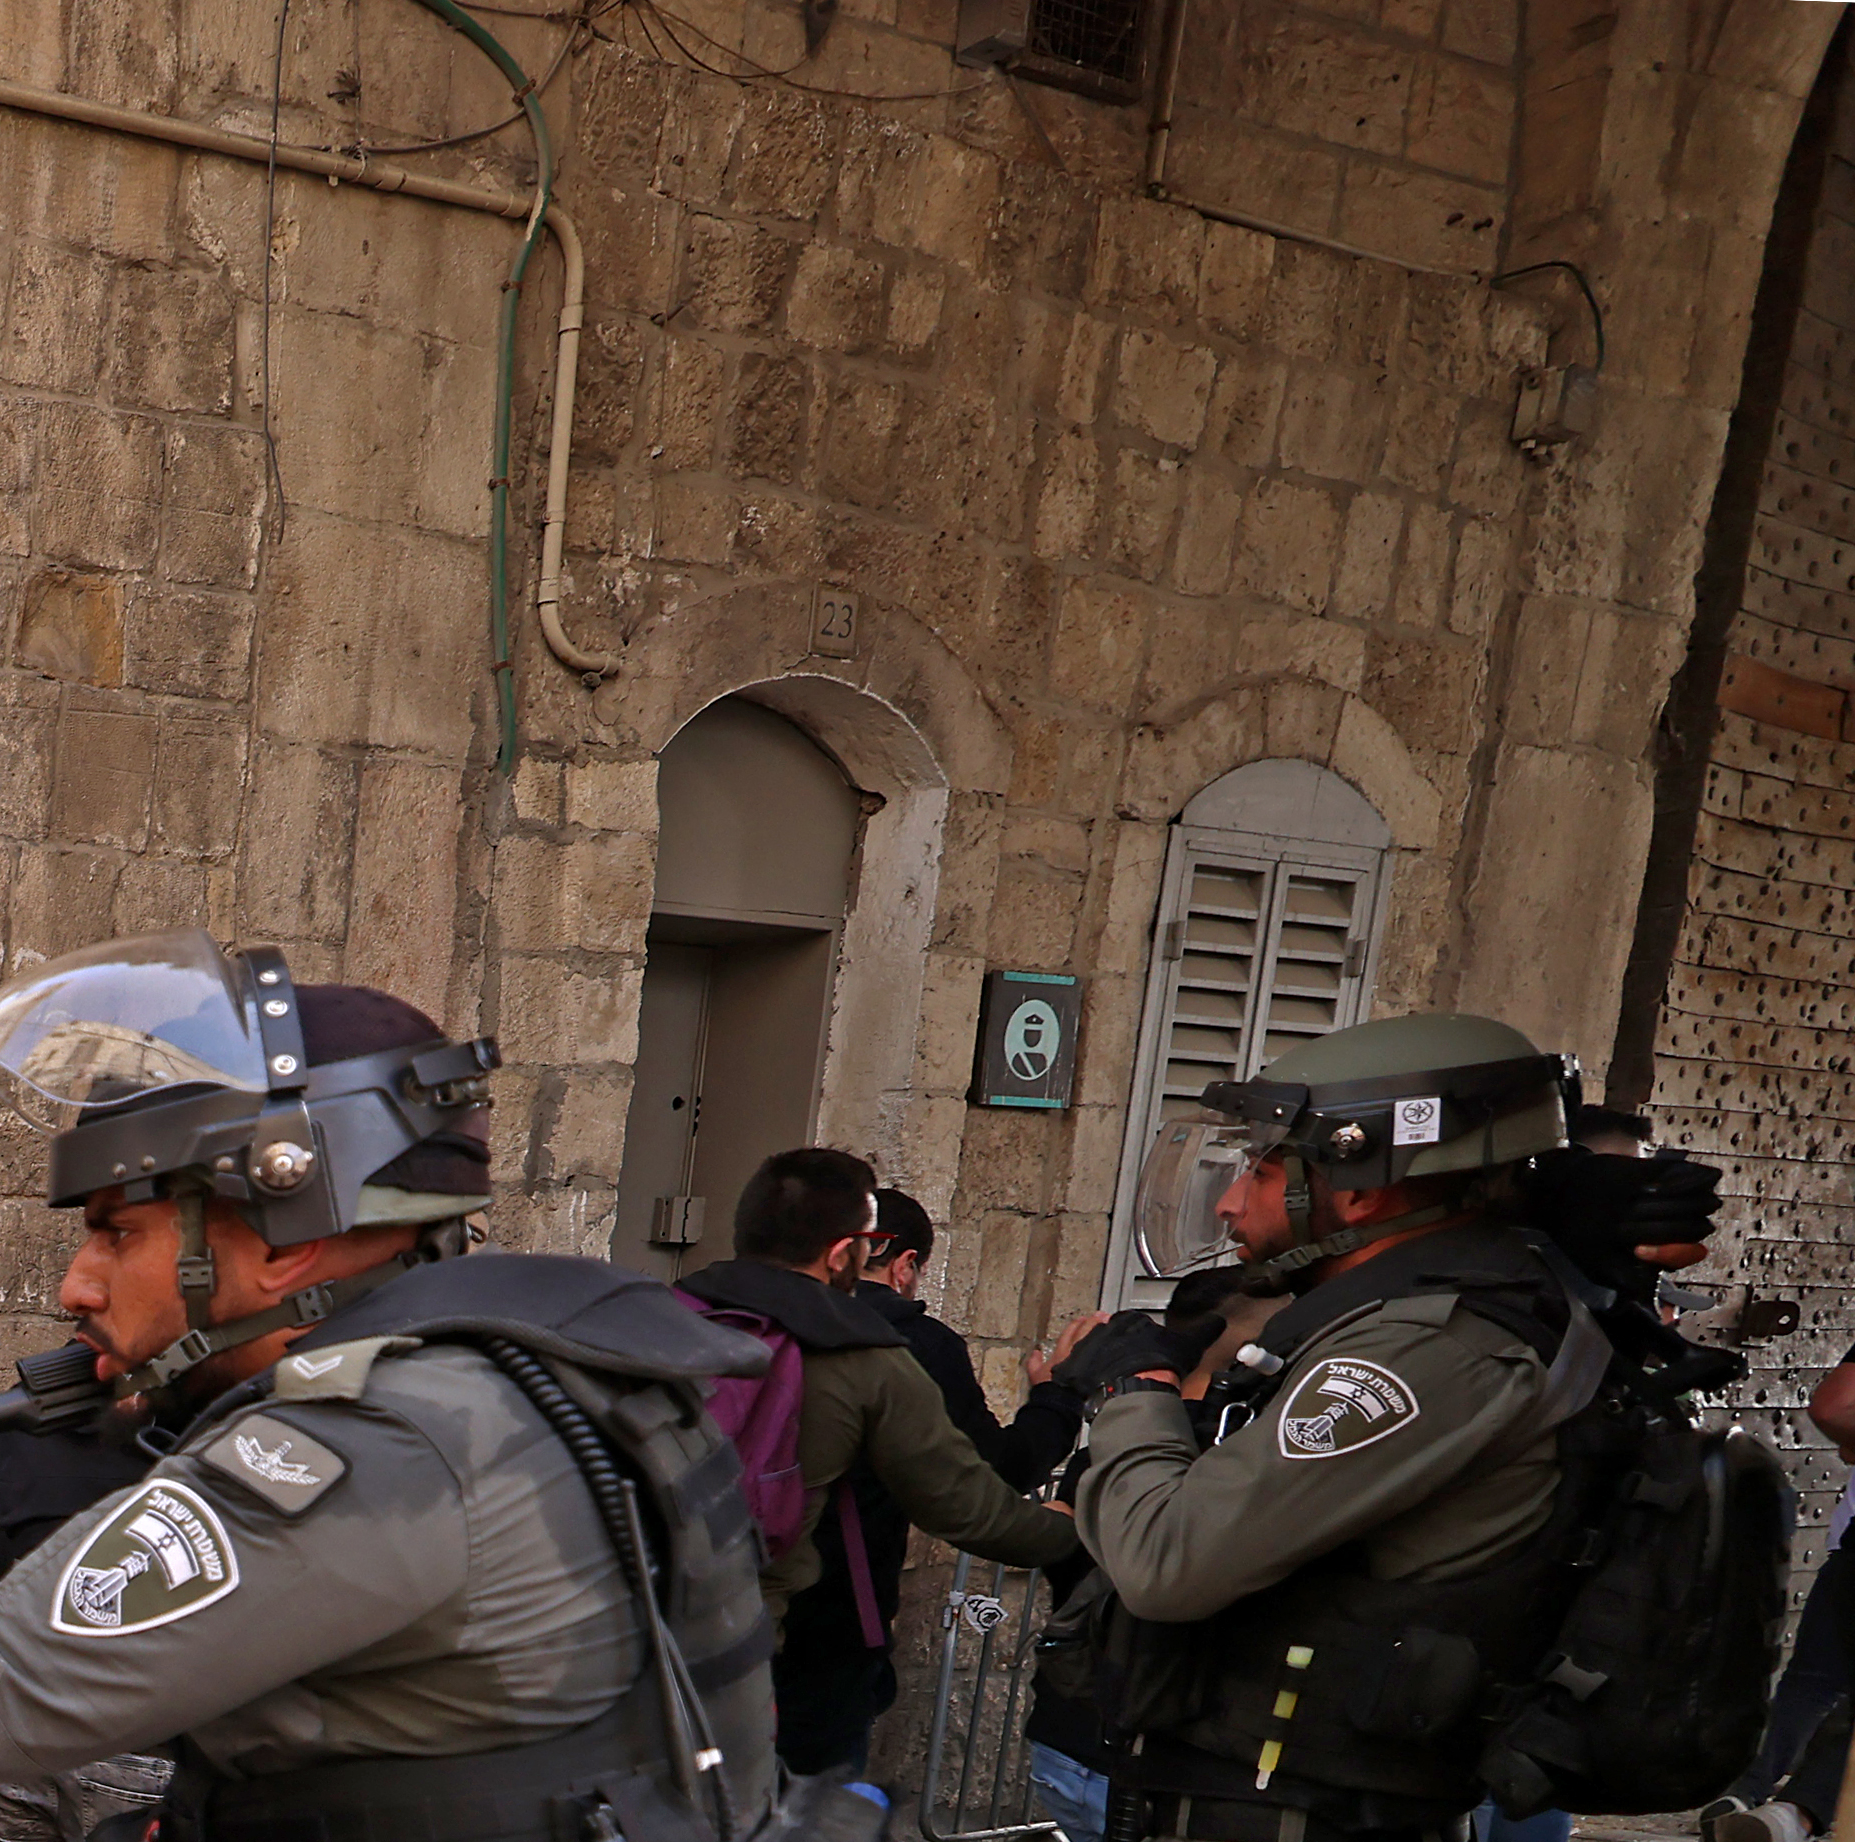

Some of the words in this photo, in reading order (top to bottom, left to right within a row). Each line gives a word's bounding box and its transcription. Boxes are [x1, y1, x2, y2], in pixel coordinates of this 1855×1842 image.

[821, 601, 853, 638] 23
[1327, 1363, 1374, 1381] ישראל
[1369, 1377, 1407, 1414] משטרת
[147, 1489, 193, 1527] ישראל
[183, 1519, 224, 1582] משטרת
